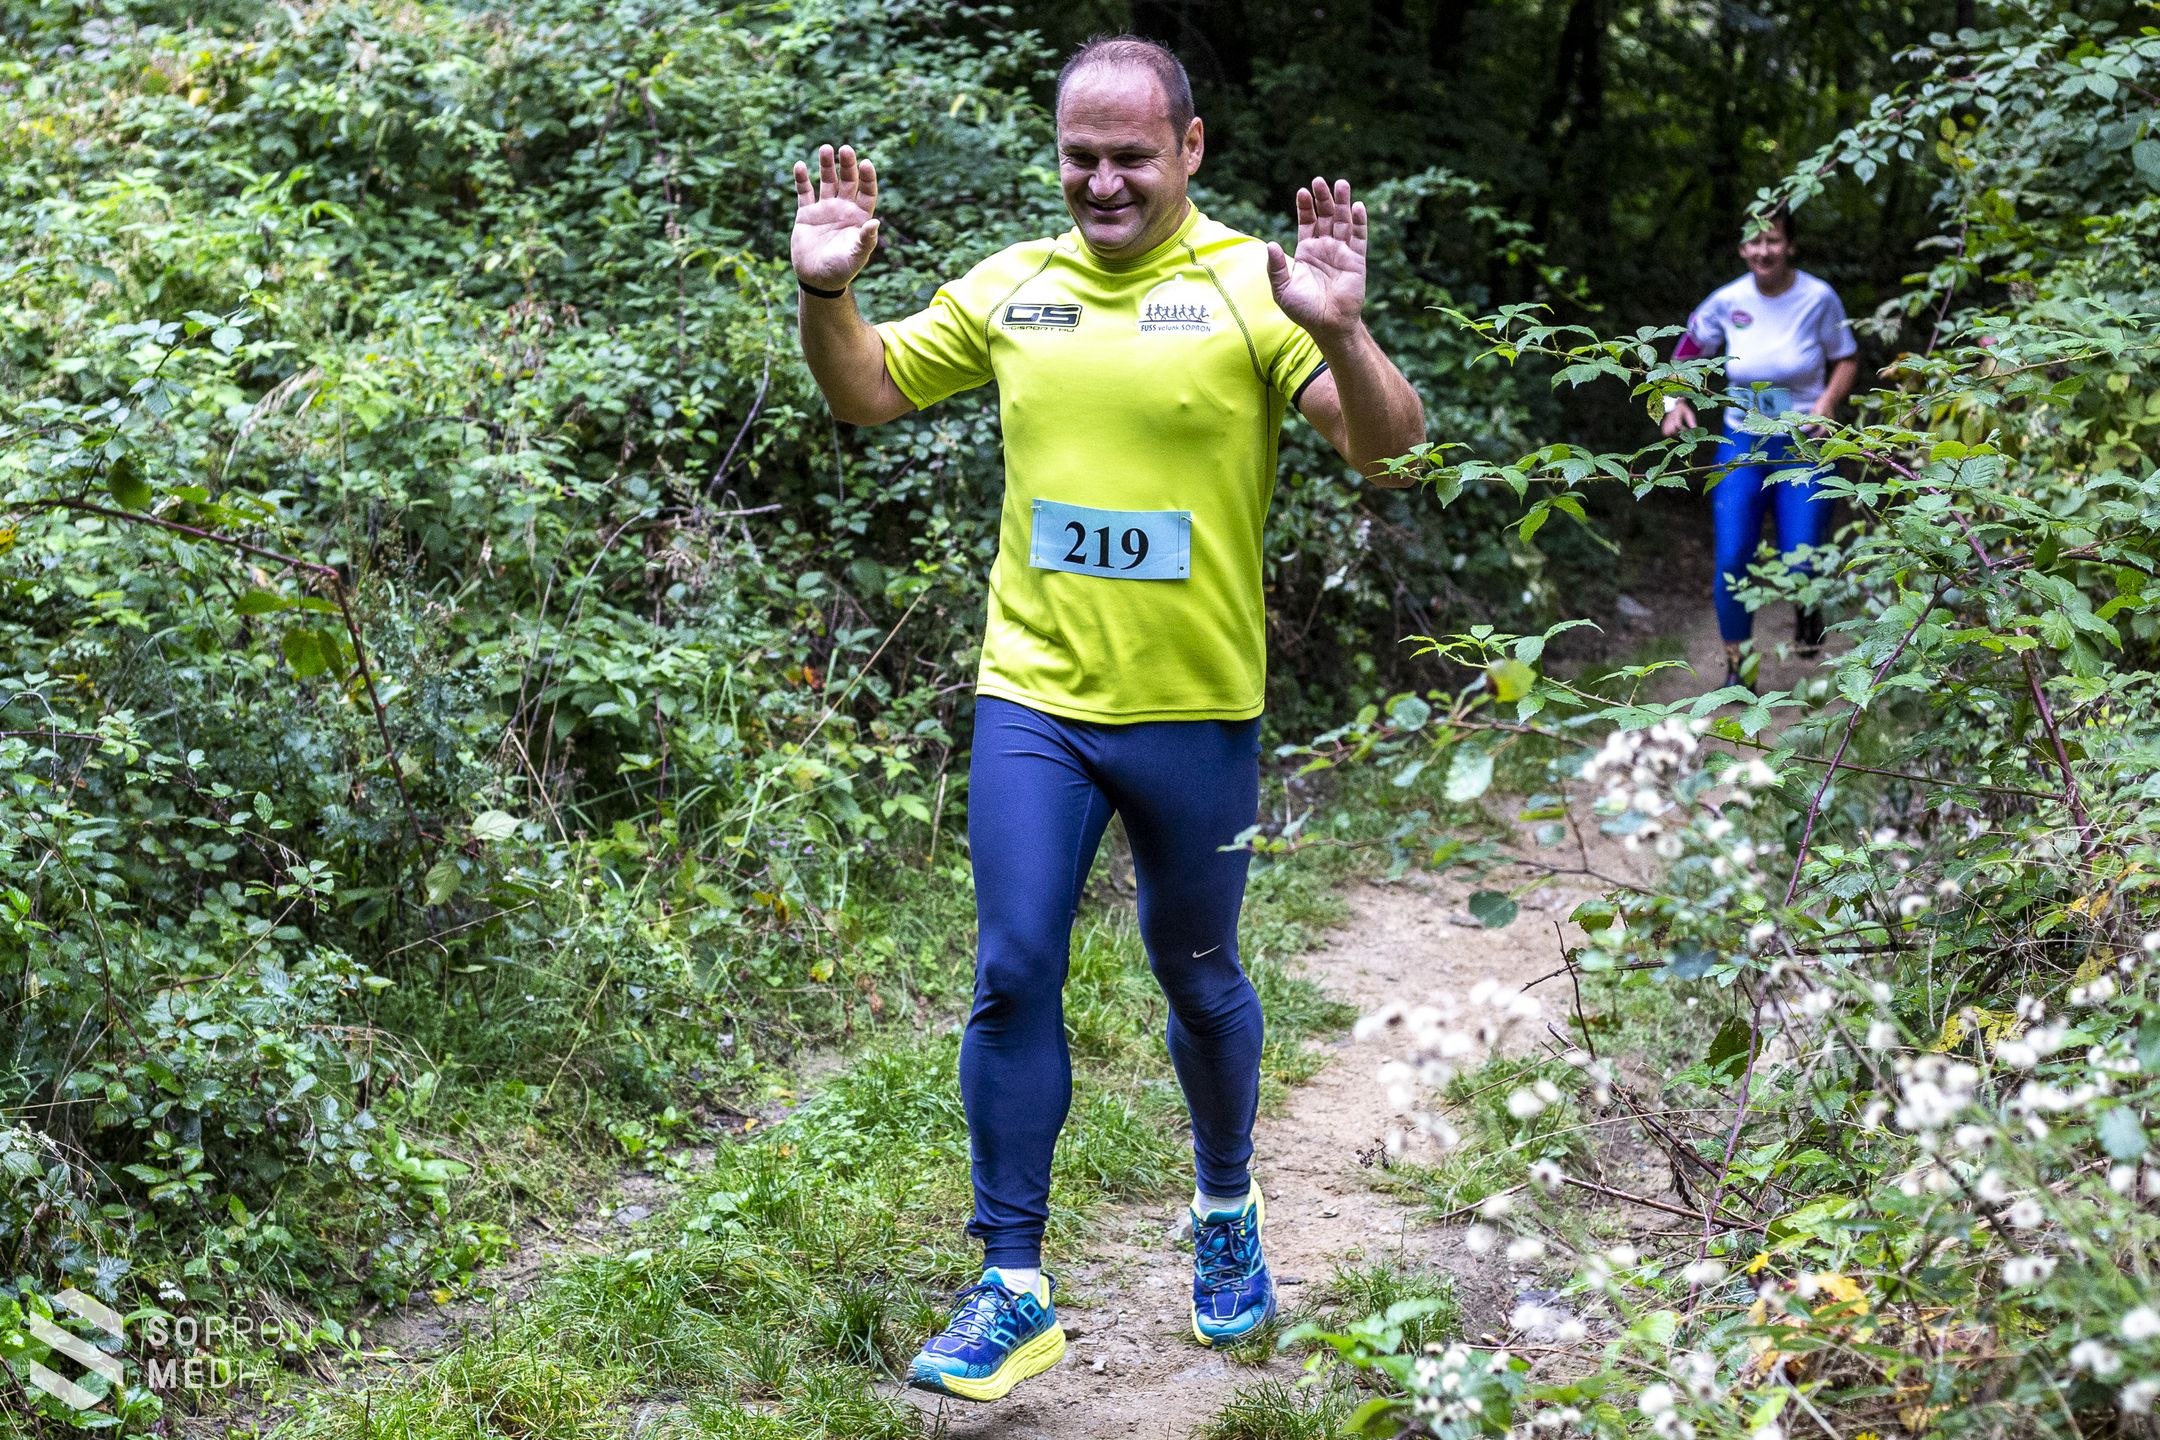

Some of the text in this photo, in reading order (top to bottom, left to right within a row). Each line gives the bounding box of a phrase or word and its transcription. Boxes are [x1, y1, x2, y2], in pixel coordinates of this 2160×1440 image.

[1140, 324, 1157, 332] FUSS
[1181, 324, 1211, 332] SOPRON
[1063, 520, 1149, 570] 219
